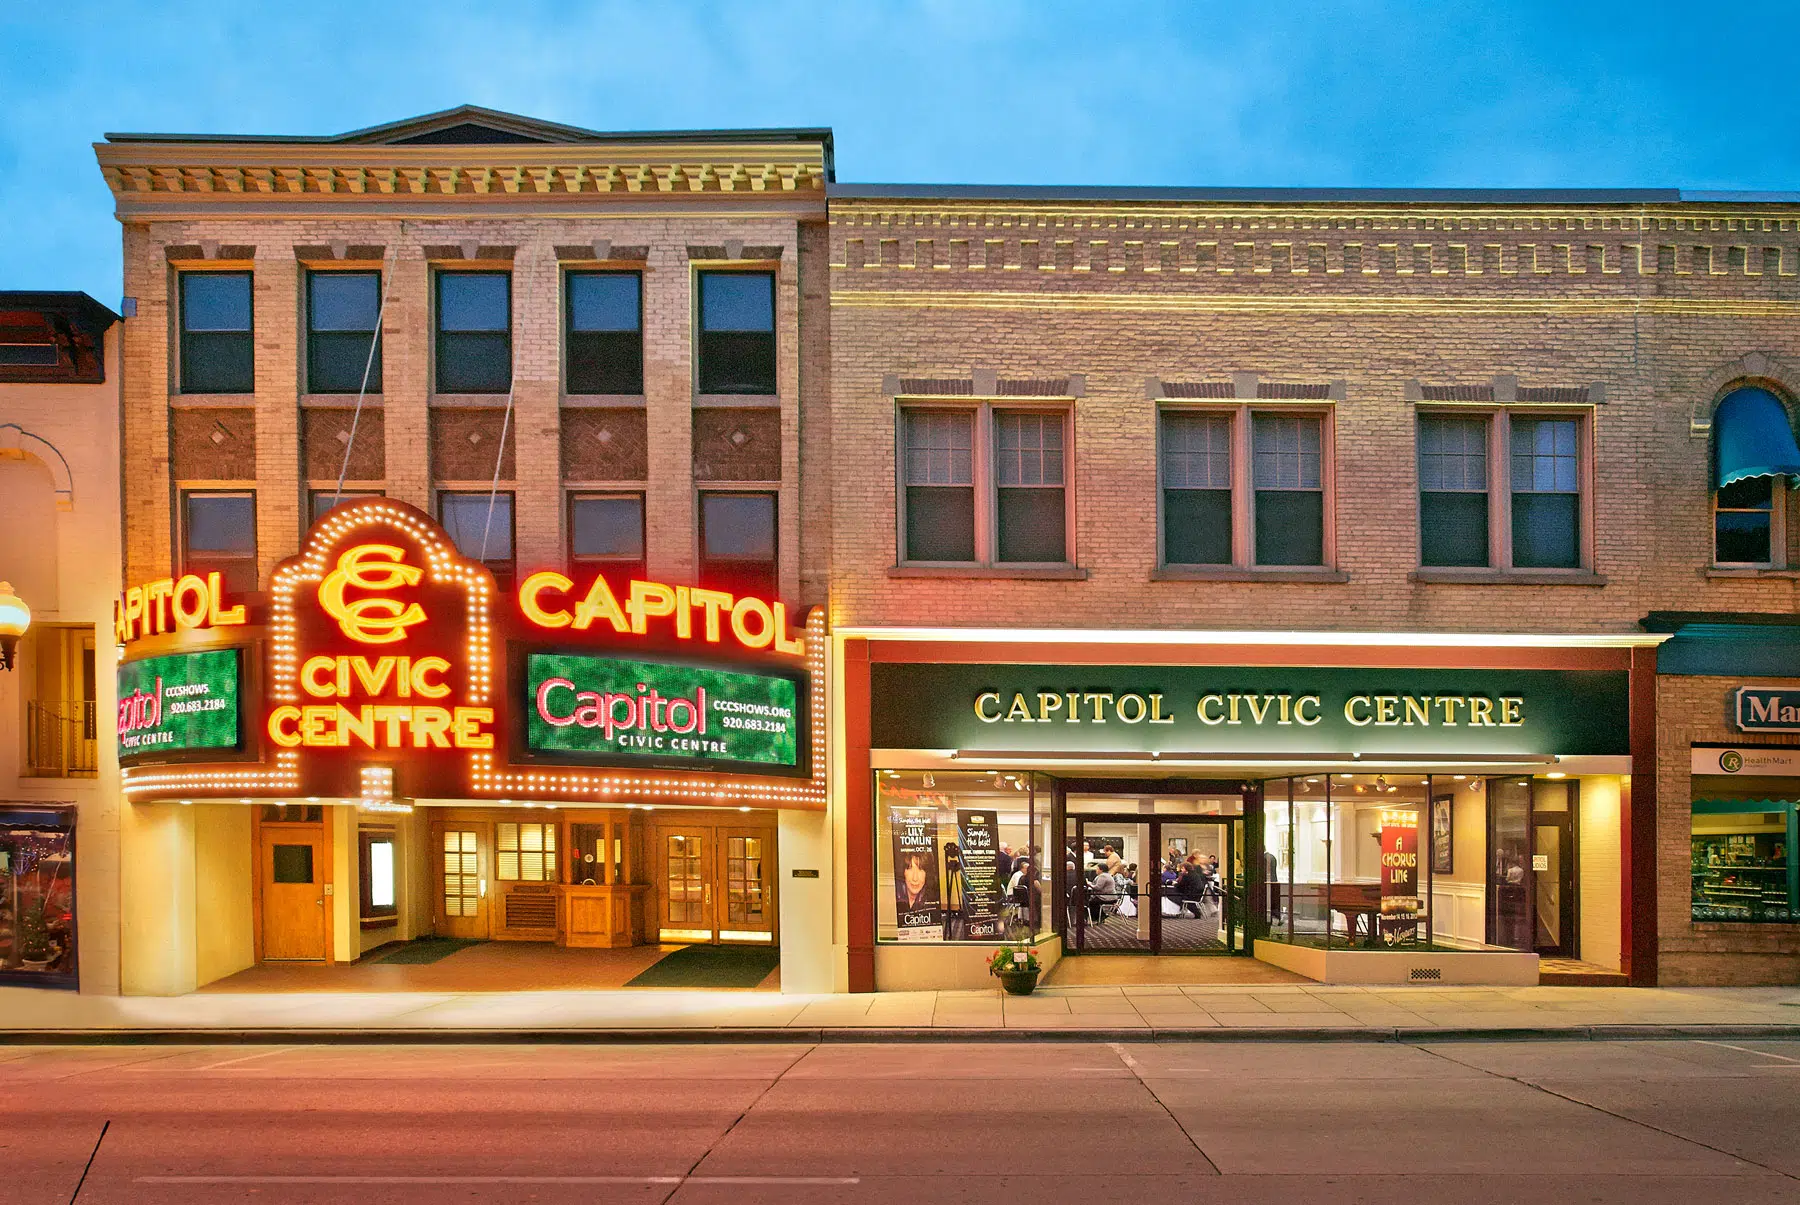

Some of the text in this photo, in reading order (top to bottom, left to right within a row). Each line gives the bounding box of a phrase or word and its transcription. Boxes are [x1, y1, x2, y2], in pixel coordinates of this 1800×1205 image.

[114, 572, 245, 646] APITOL
[519, 571, 805, 656] CAPITOL
[301, 655, 452, 698] CIVIC
[118, 676, 162, 744] apitol
[170, 699, 226, 714] 920.683.2184
[536, 677, 706, 741] Capitol
[713, 700, 791, 718] CCCSHOWS.ORG
[974, 692, 1525, 727] CAPITOL CIVIC CENTRE
[268, 702, 494, 749] CENTRE
[723, 717, 787, 733] 920.683.2184
[142, 731, 173, 745] CENTRE
[618, 734, 728, 753] CIVIC CENTRE
[1395, 836, 1403, 851] A
[1382, 852, 1416, 868] CHORUS
[1390, 869, 1408, 884] LINE
[904, 912, 931, 926] Capitol
[970, 923, 994, 936] Capitol
